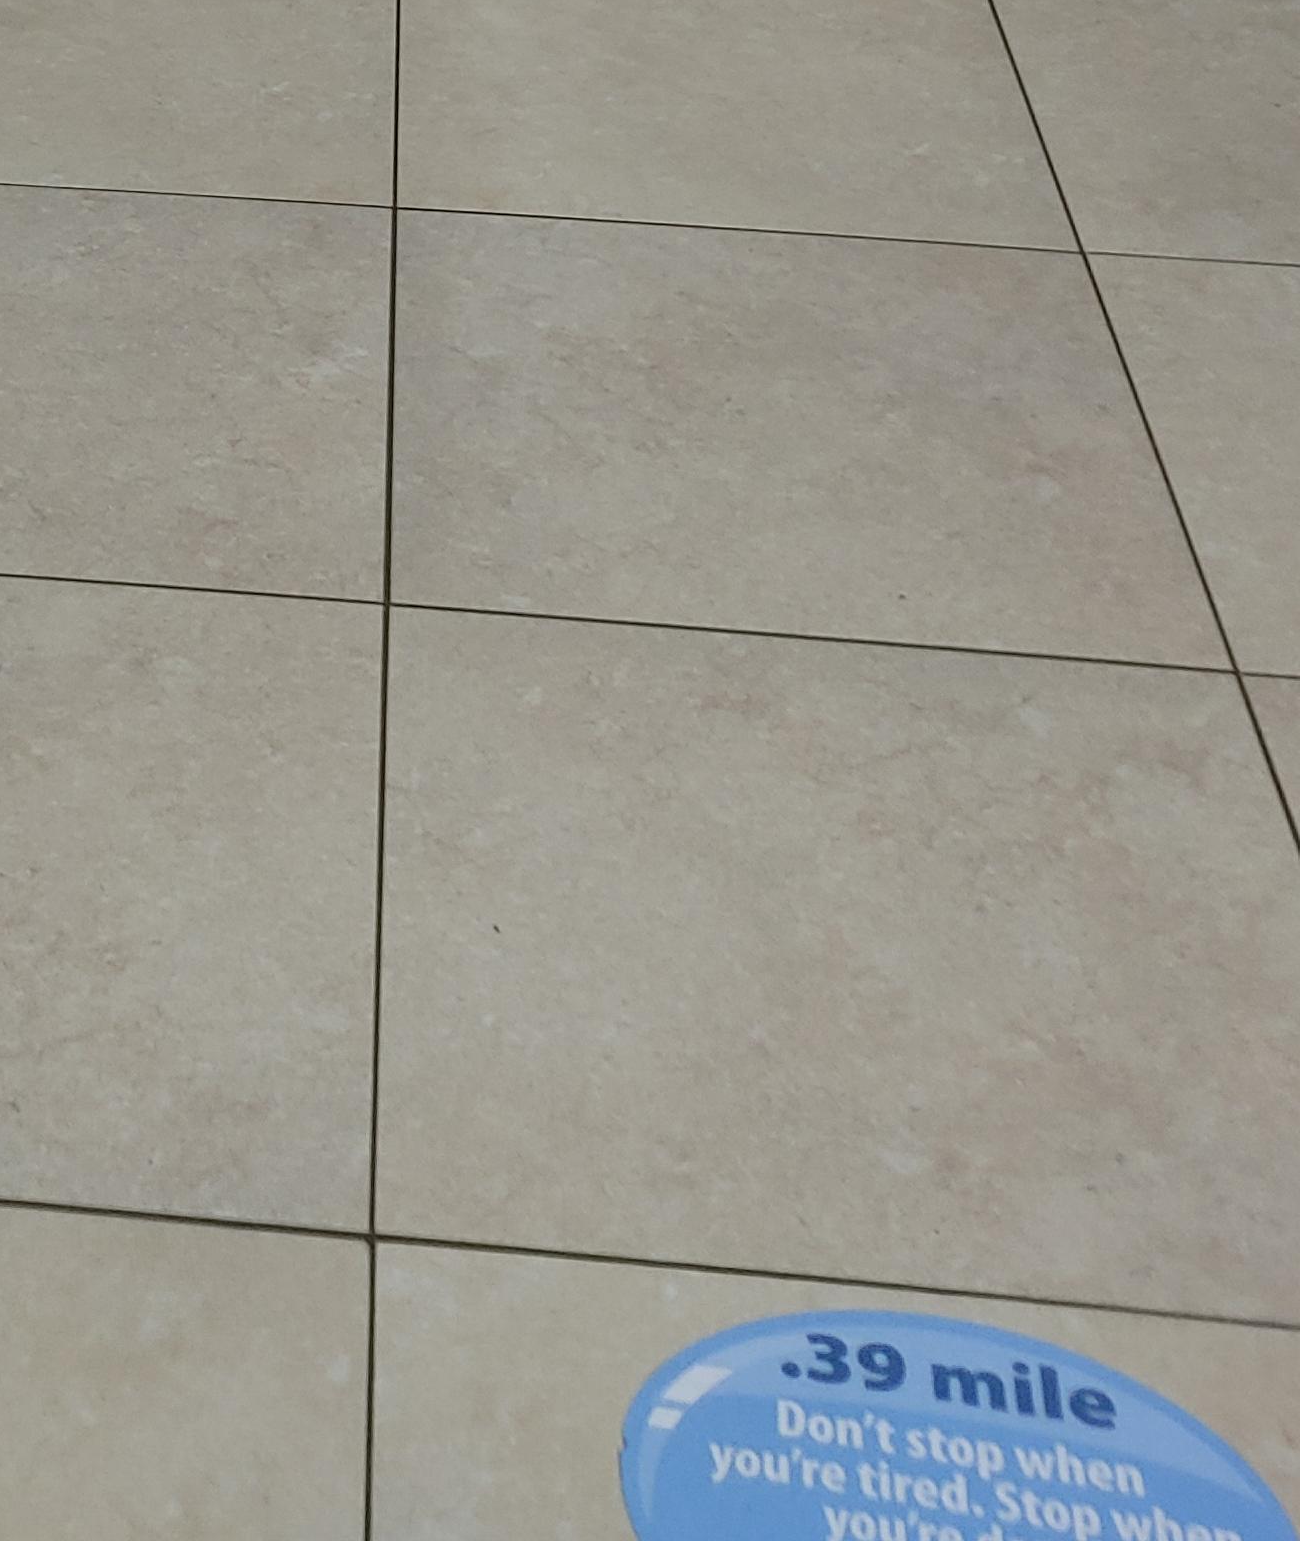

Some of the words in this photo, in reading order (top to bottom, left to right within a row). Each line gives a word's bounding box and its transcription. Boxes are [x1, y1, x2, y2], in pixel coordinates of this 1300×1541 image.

[780, 1332, 906, 1392] .39
[932, 1361, 1117, 1430] mile
[709, 1441, 847, 1494] you're
[857, 1460, 986, 1517] tired.
[993, 1480, 1102, 1541] Stop
[776, 1399, 897, 1455] Don't
[905, 1426, 1004, 1481] stop
[1013, 1443, 1146, 1499] when
